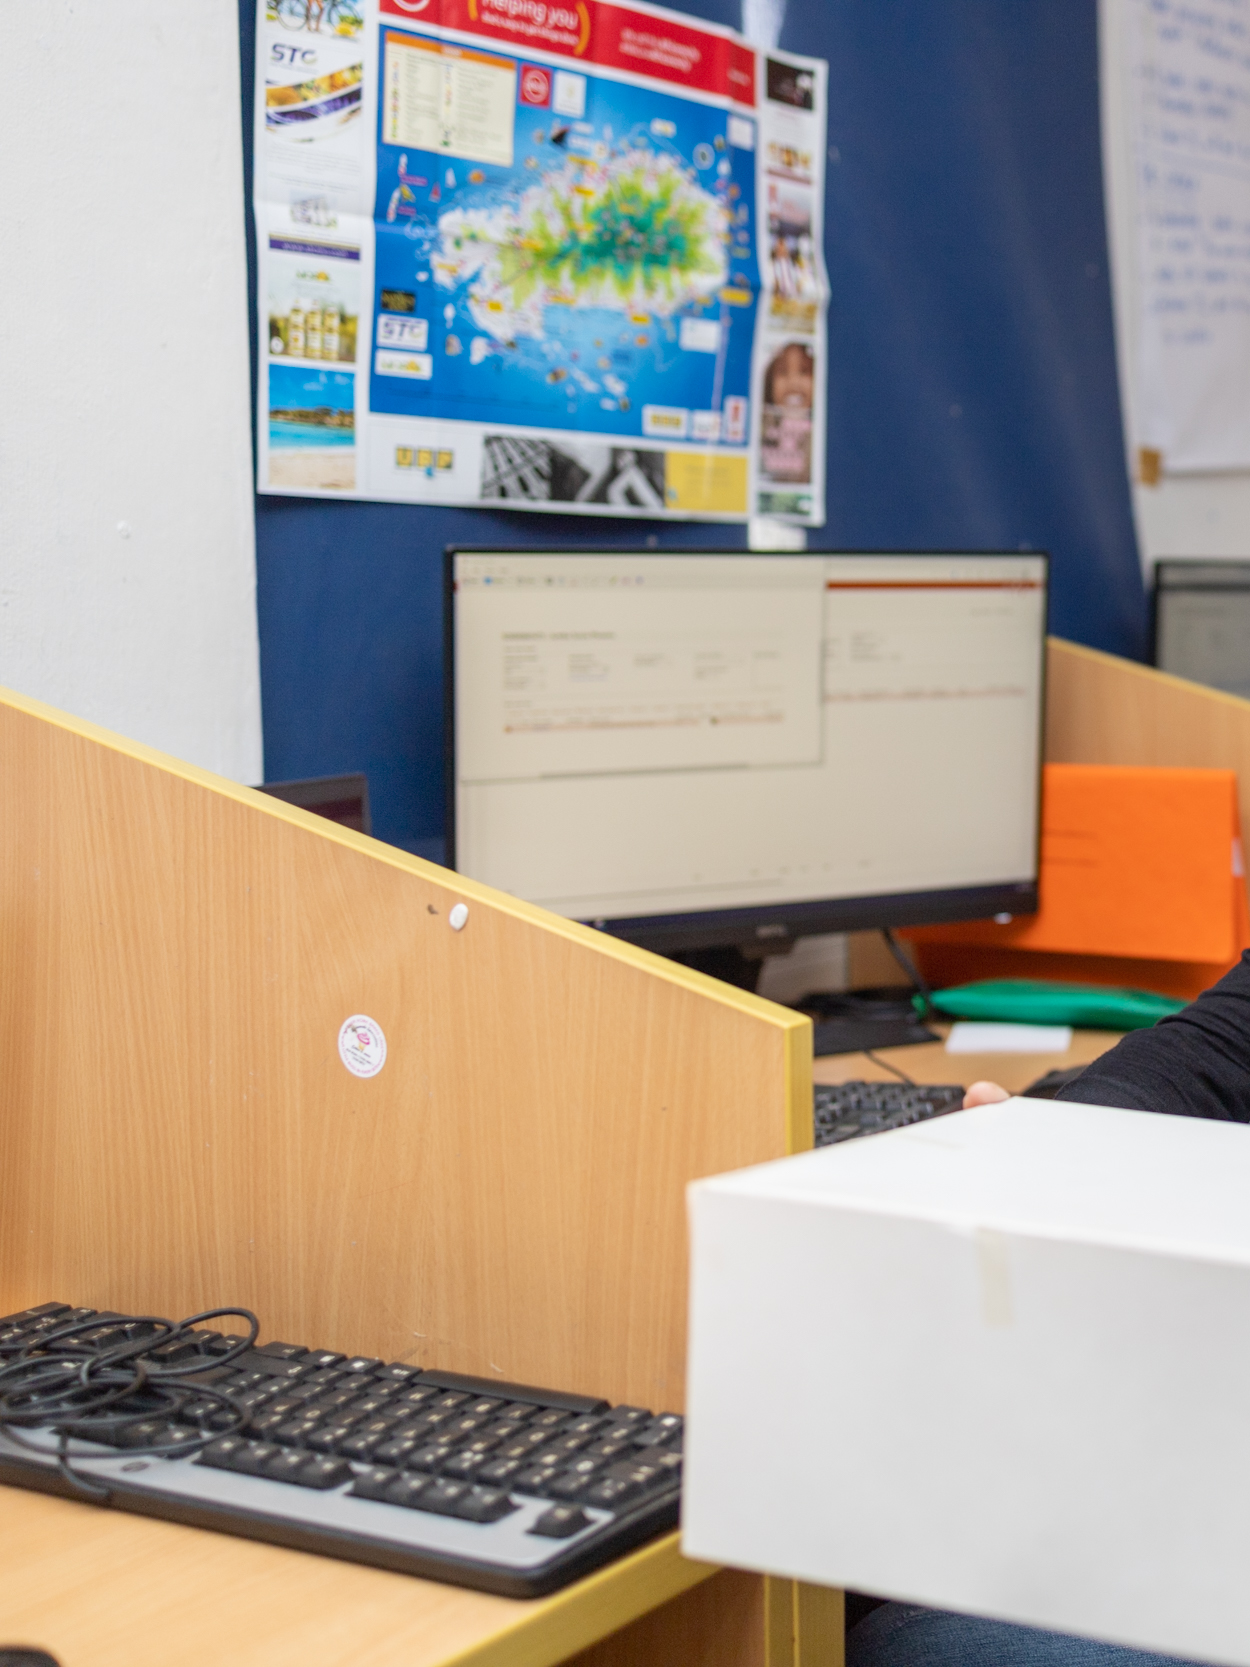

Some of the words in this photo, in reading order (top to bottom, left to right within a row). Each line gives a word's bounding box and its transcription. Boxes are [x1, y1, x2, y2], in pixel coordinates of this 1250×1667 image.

[545, 6, 579, 30] you
[270, 43, 317, 64] STC
[381, 321, 422, 340] STC
